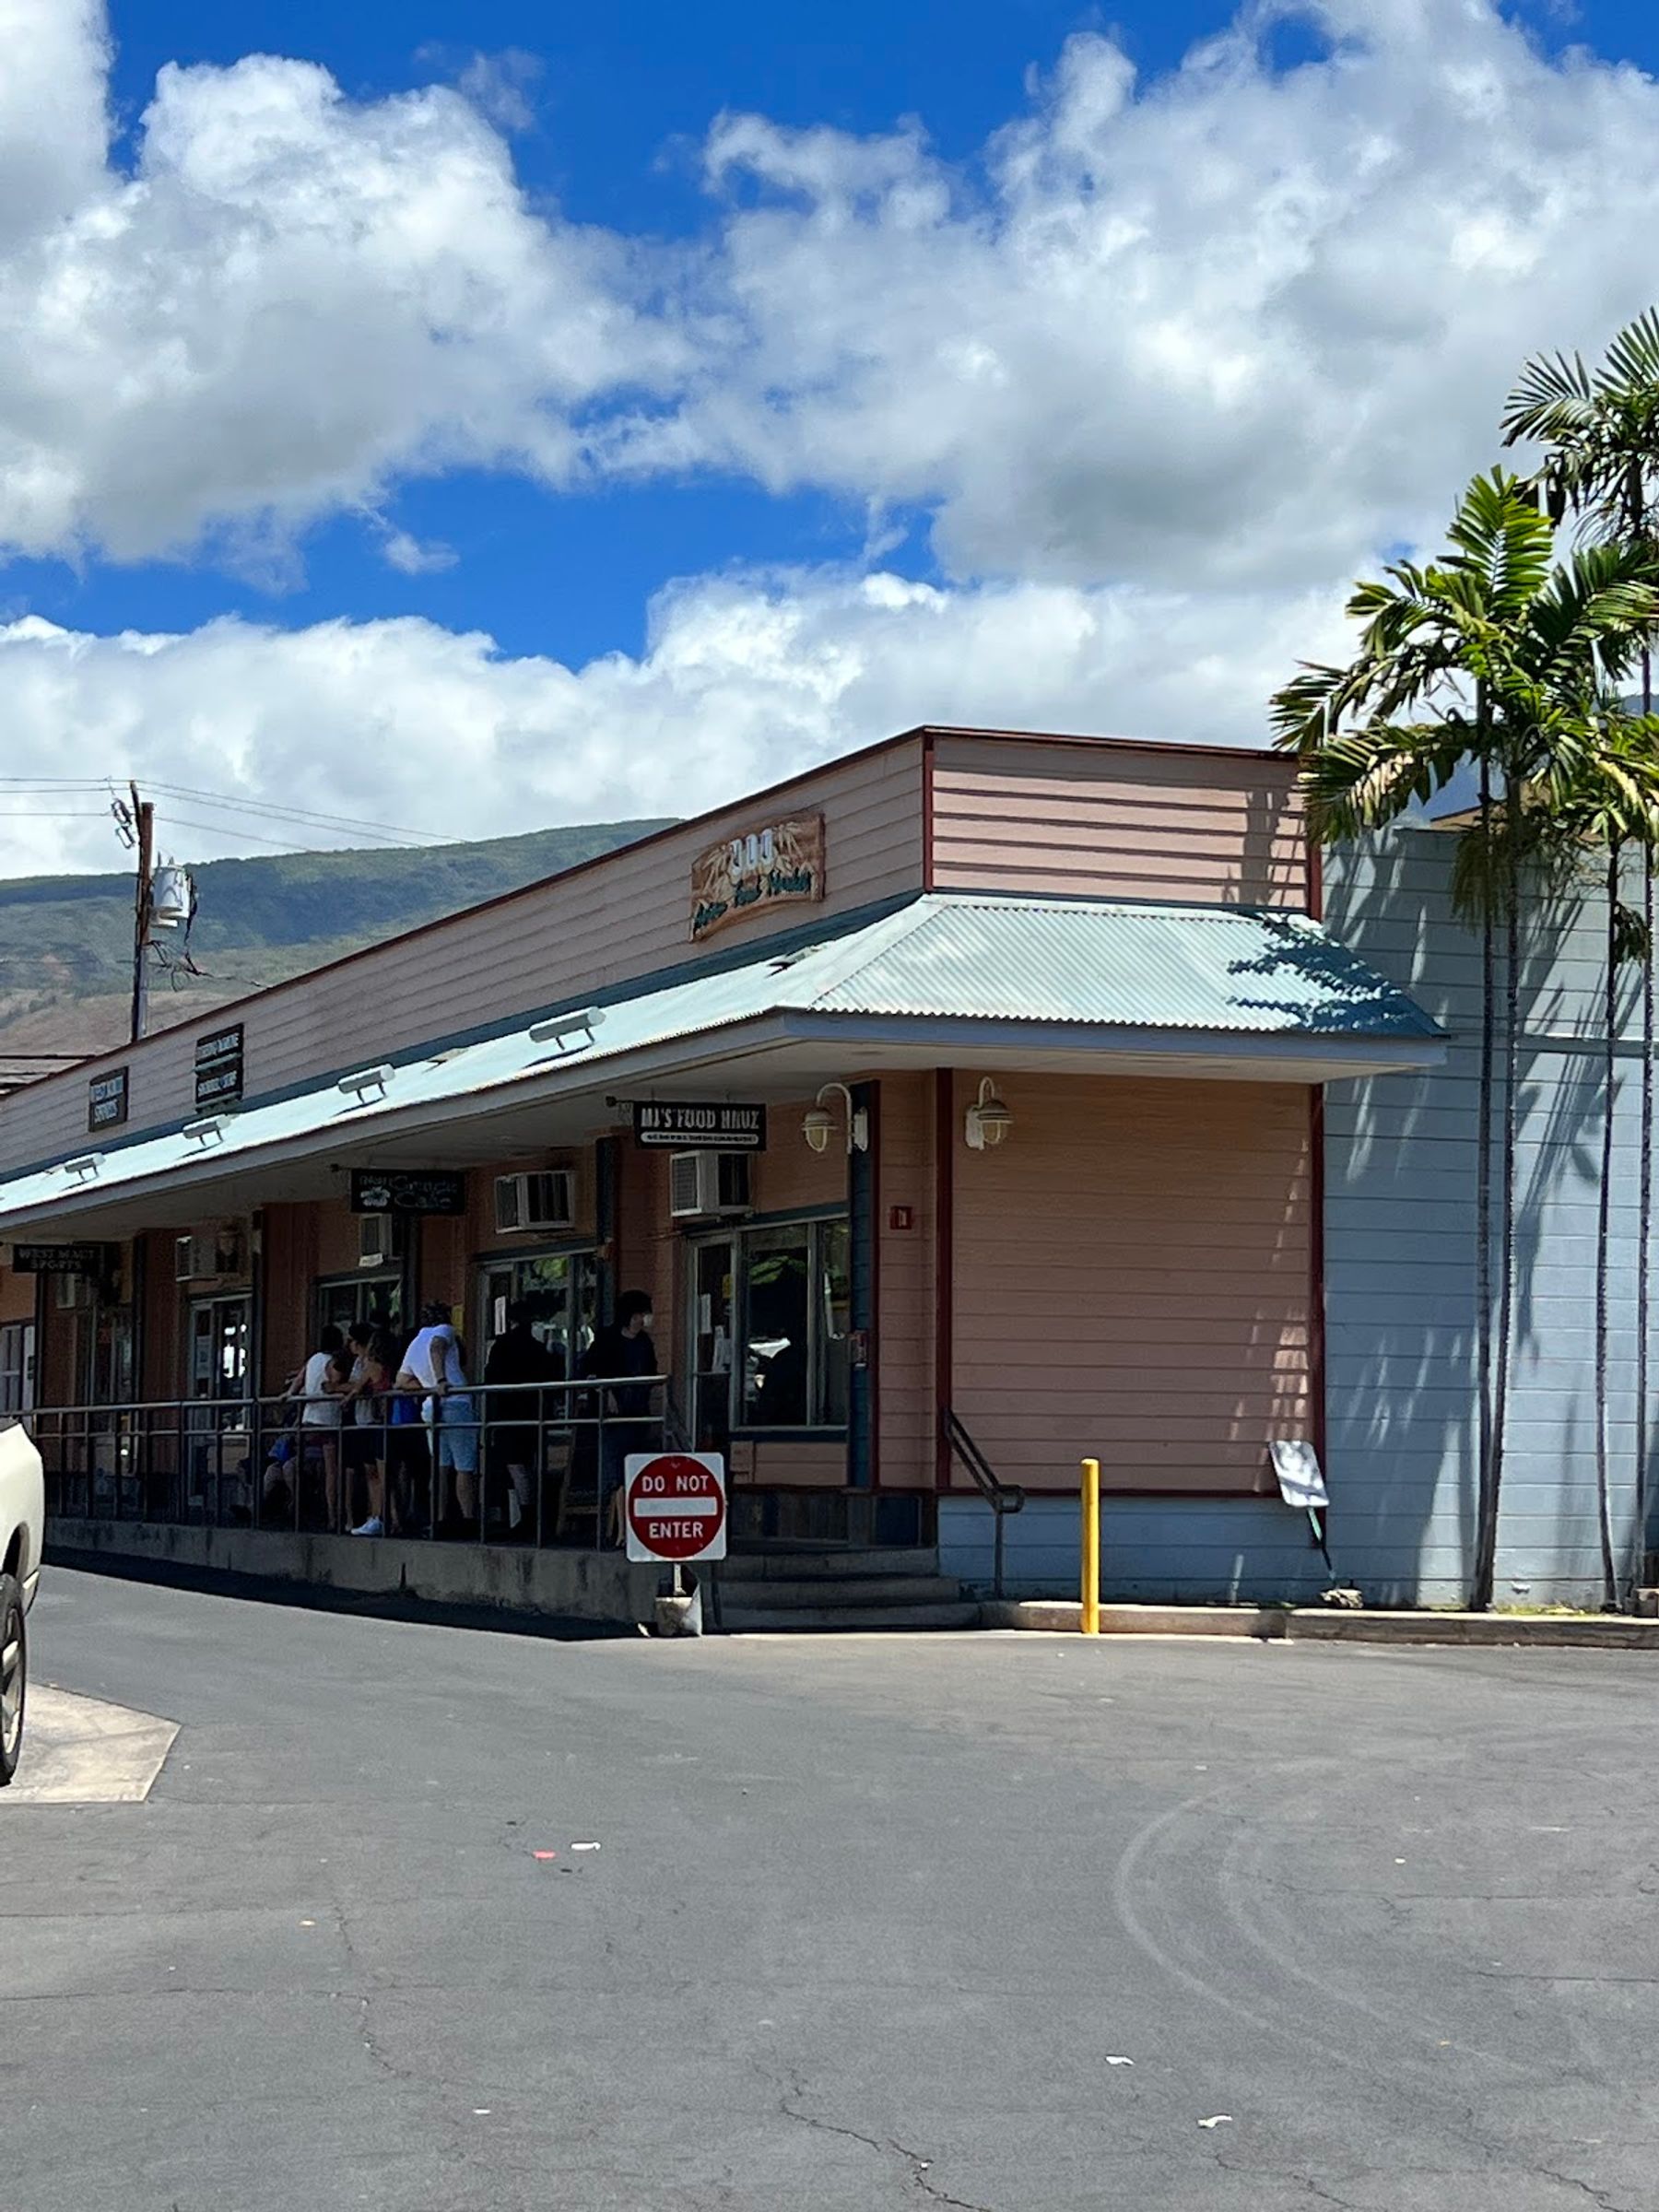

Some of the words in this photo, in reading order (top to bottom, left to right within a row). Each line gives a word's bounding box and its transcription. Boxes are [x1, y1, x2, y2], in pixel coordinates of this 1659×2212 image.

[677, 1108, 716, 1129] FOOD
[641, 1475, 665, 1492] DO
[676, 1475, 709, 1491] NOT
[648, 1521, 703, 1539] ENTER
